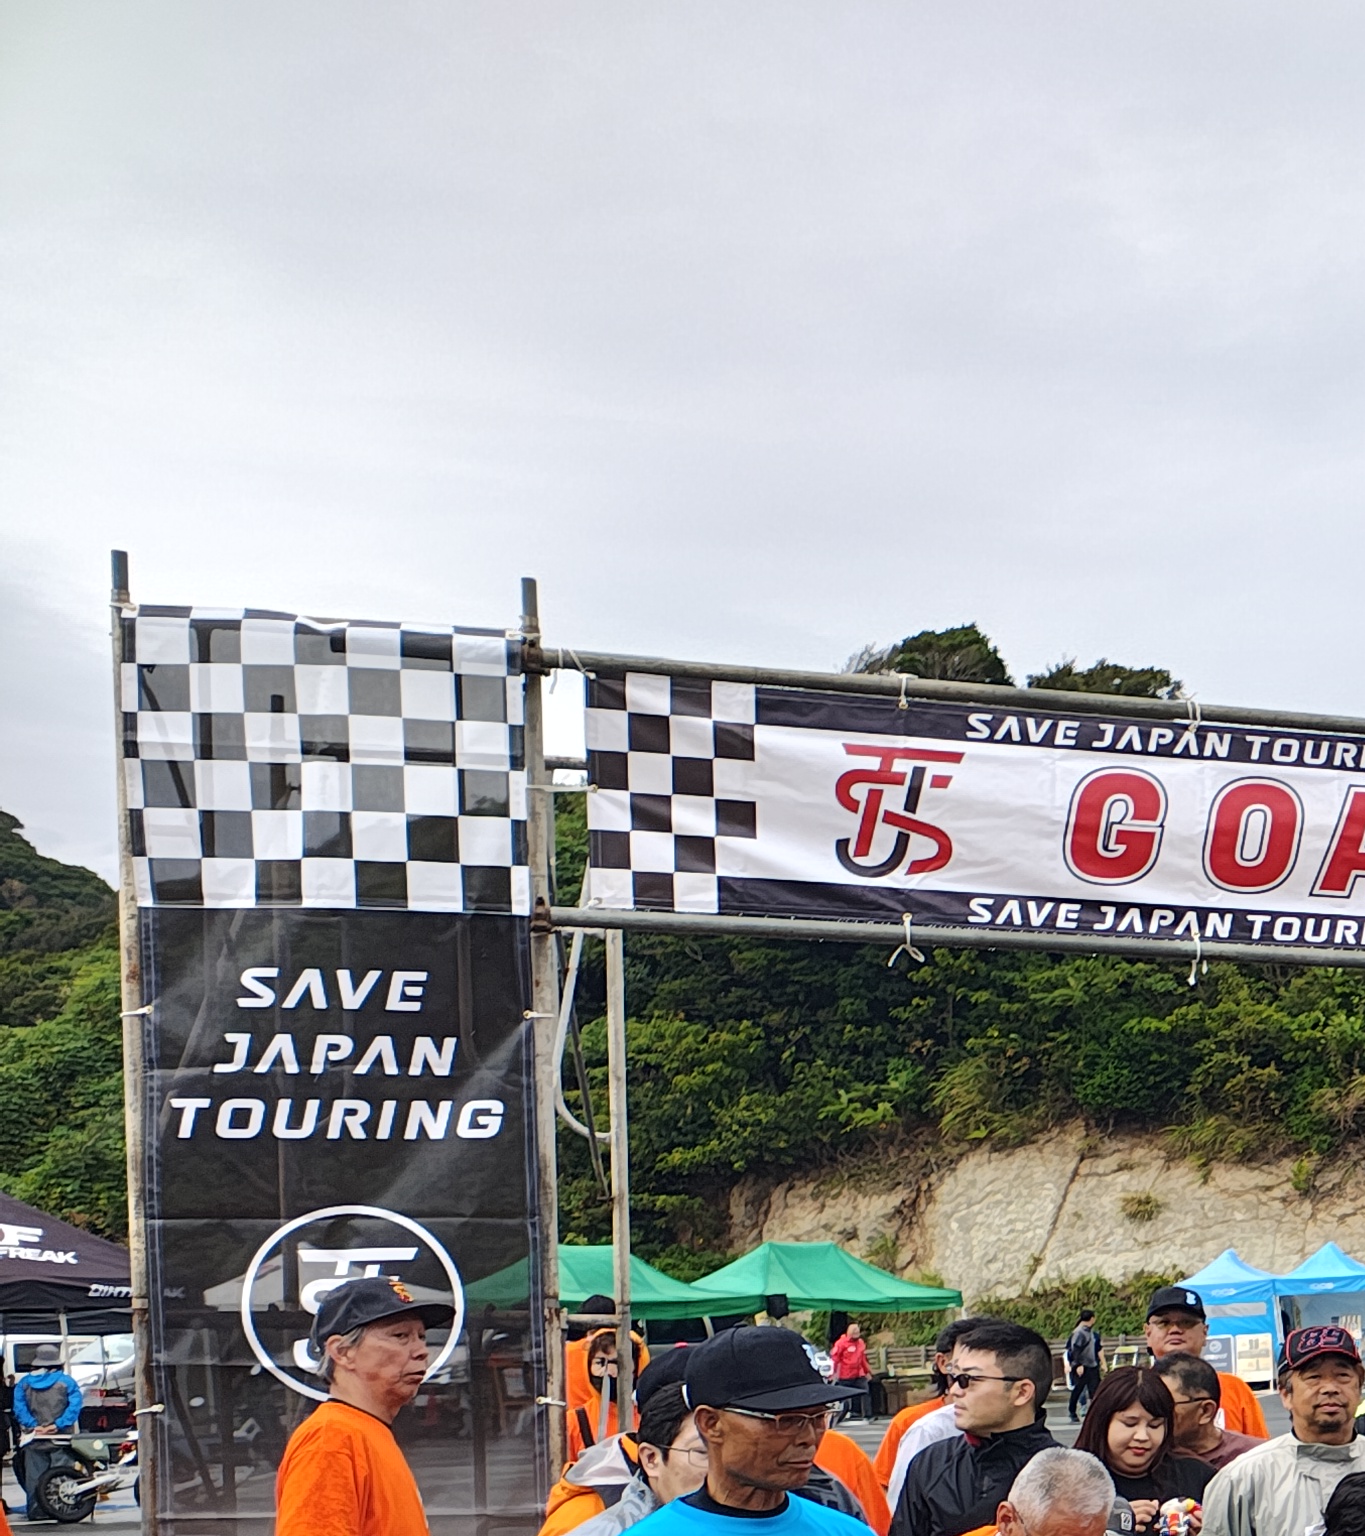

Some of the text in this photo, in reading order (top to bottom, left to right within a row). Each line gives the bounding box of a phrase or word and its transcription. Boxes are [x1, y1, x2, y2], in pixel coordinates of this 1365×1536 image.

[966, 713, 1080, 747] SAVE
[1091, 722, 1231, 757] JAPAN
[967, 897, 1081, 931] SAVE
[1093, 905, 1233, 939] JAPAN
[236, 966, 428, 1013] SAVE
[212, 1033, 458, 1077] JAPAN
[169, 1097, 505, 1142] TOURING
